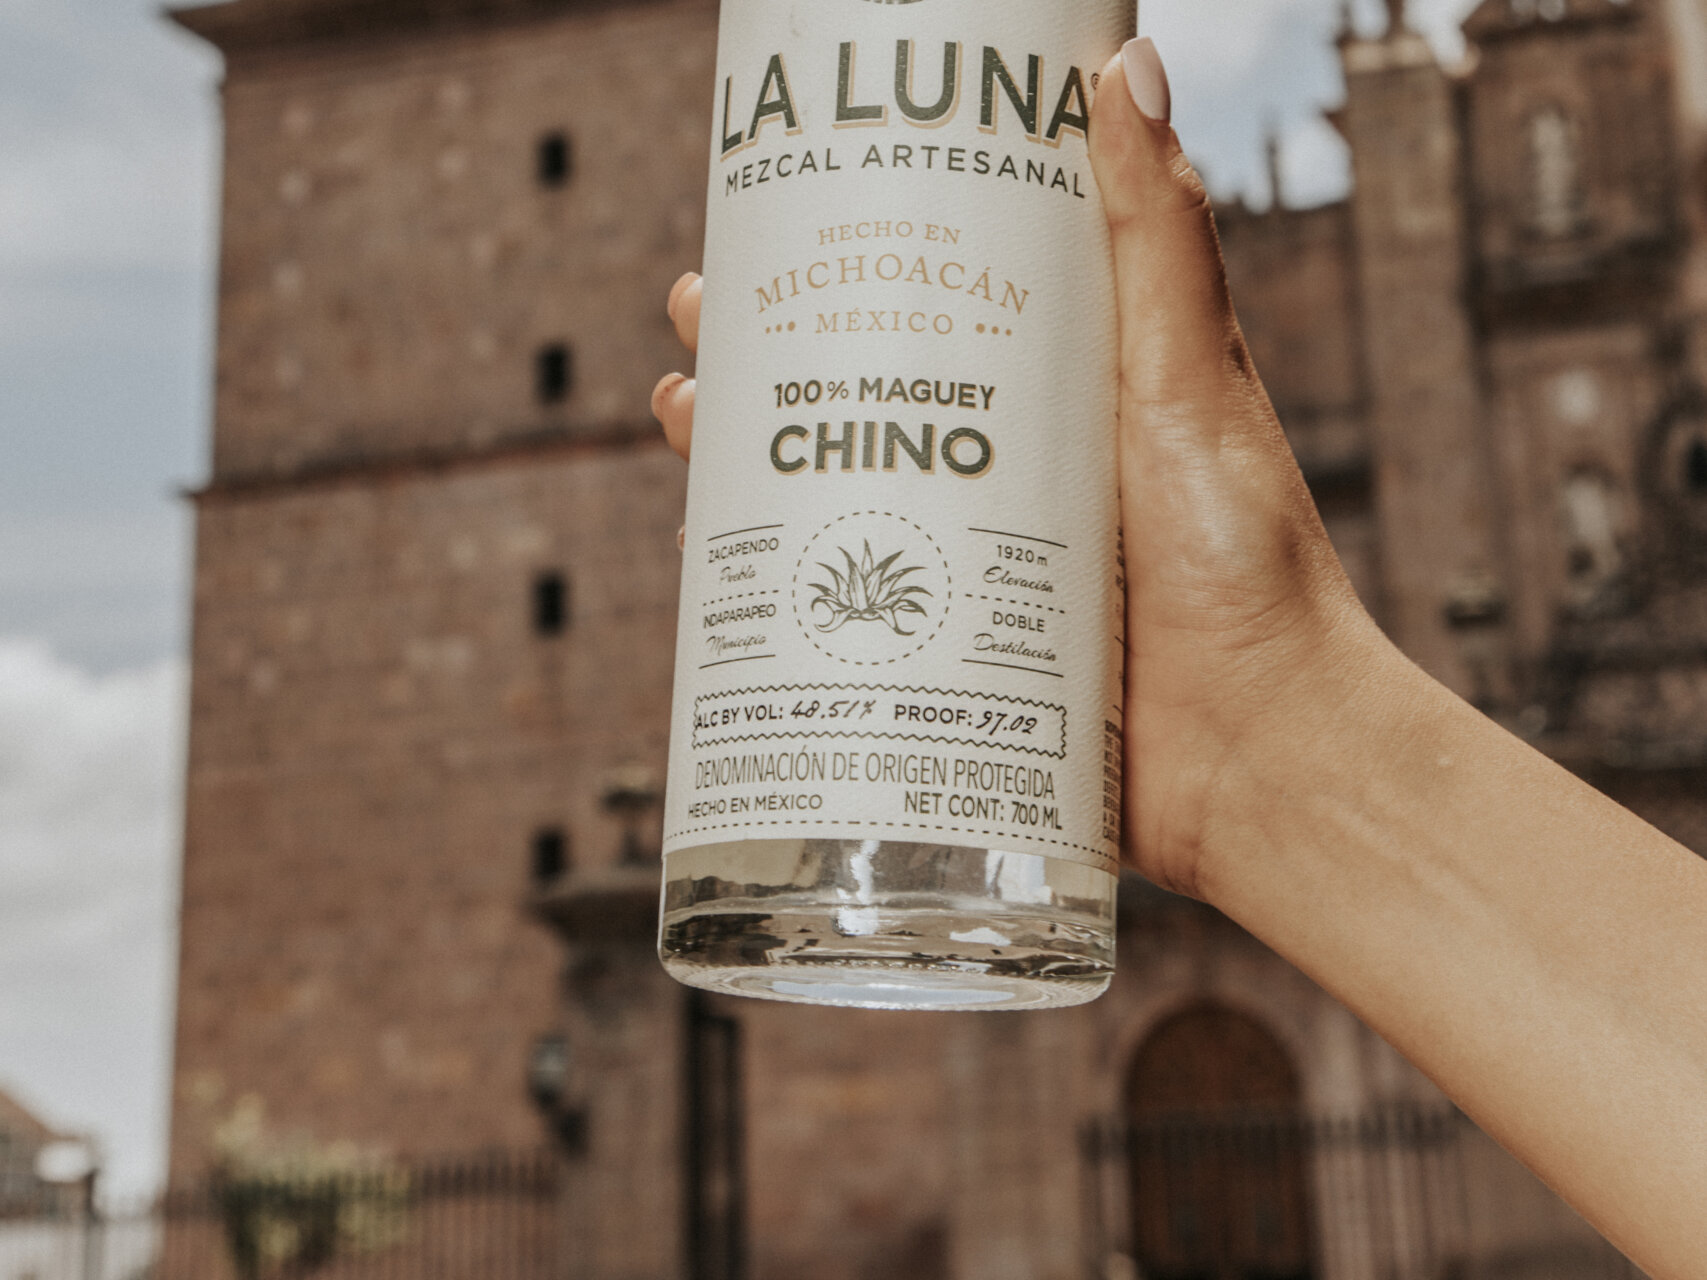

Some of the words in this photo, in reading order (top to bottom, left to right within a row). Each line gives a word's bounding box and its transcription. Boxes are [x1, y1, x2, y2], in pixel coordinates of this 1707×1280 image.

[721, 53, 803, 160] LA
[726, 147, 841, 196] MEZCAL
[861, 144, 1085, 199] ARTESANAL
[818, 220, 914, 246] HECHO
[924, 223, 961, 245] EN
[754, 253, 1029, 315] MICHOACÁN
[815, 307, 953, 335] MÉXICO
[773, 379, 849, 408] 100%
[858, 377, 996, 410] MAGUEY
[769, 420, 995, 480] CHINO
[707, 537, 780, 564] ZACAPENDO
[992, 611, 1045, 633] DOBLE
[973, 632, 1057, 662] Destilación
[721, 707, 741, 726] BY
[744, 703, 784, 722] VOL:
[894, 704, 973, 727] PROOF:
[695, 744, 826, 790] DENOMINACIÓN
[832, 751, 861, 782] DE
[865, 751, 948, 787] ORIGEN
[953, 758, 1056, 801] PROTEGIDA
[688, 798, 727, 819] HECHO
[730, 796, 751, 813] EN
[753, 791, 824, 812] MÉXICO
[904, 790, 943, 815] NET
[948, 793, 1005, 821] CONT:
[1011, 800, 1040, 826] 700
[1042, 805, 1063, 831] ML
